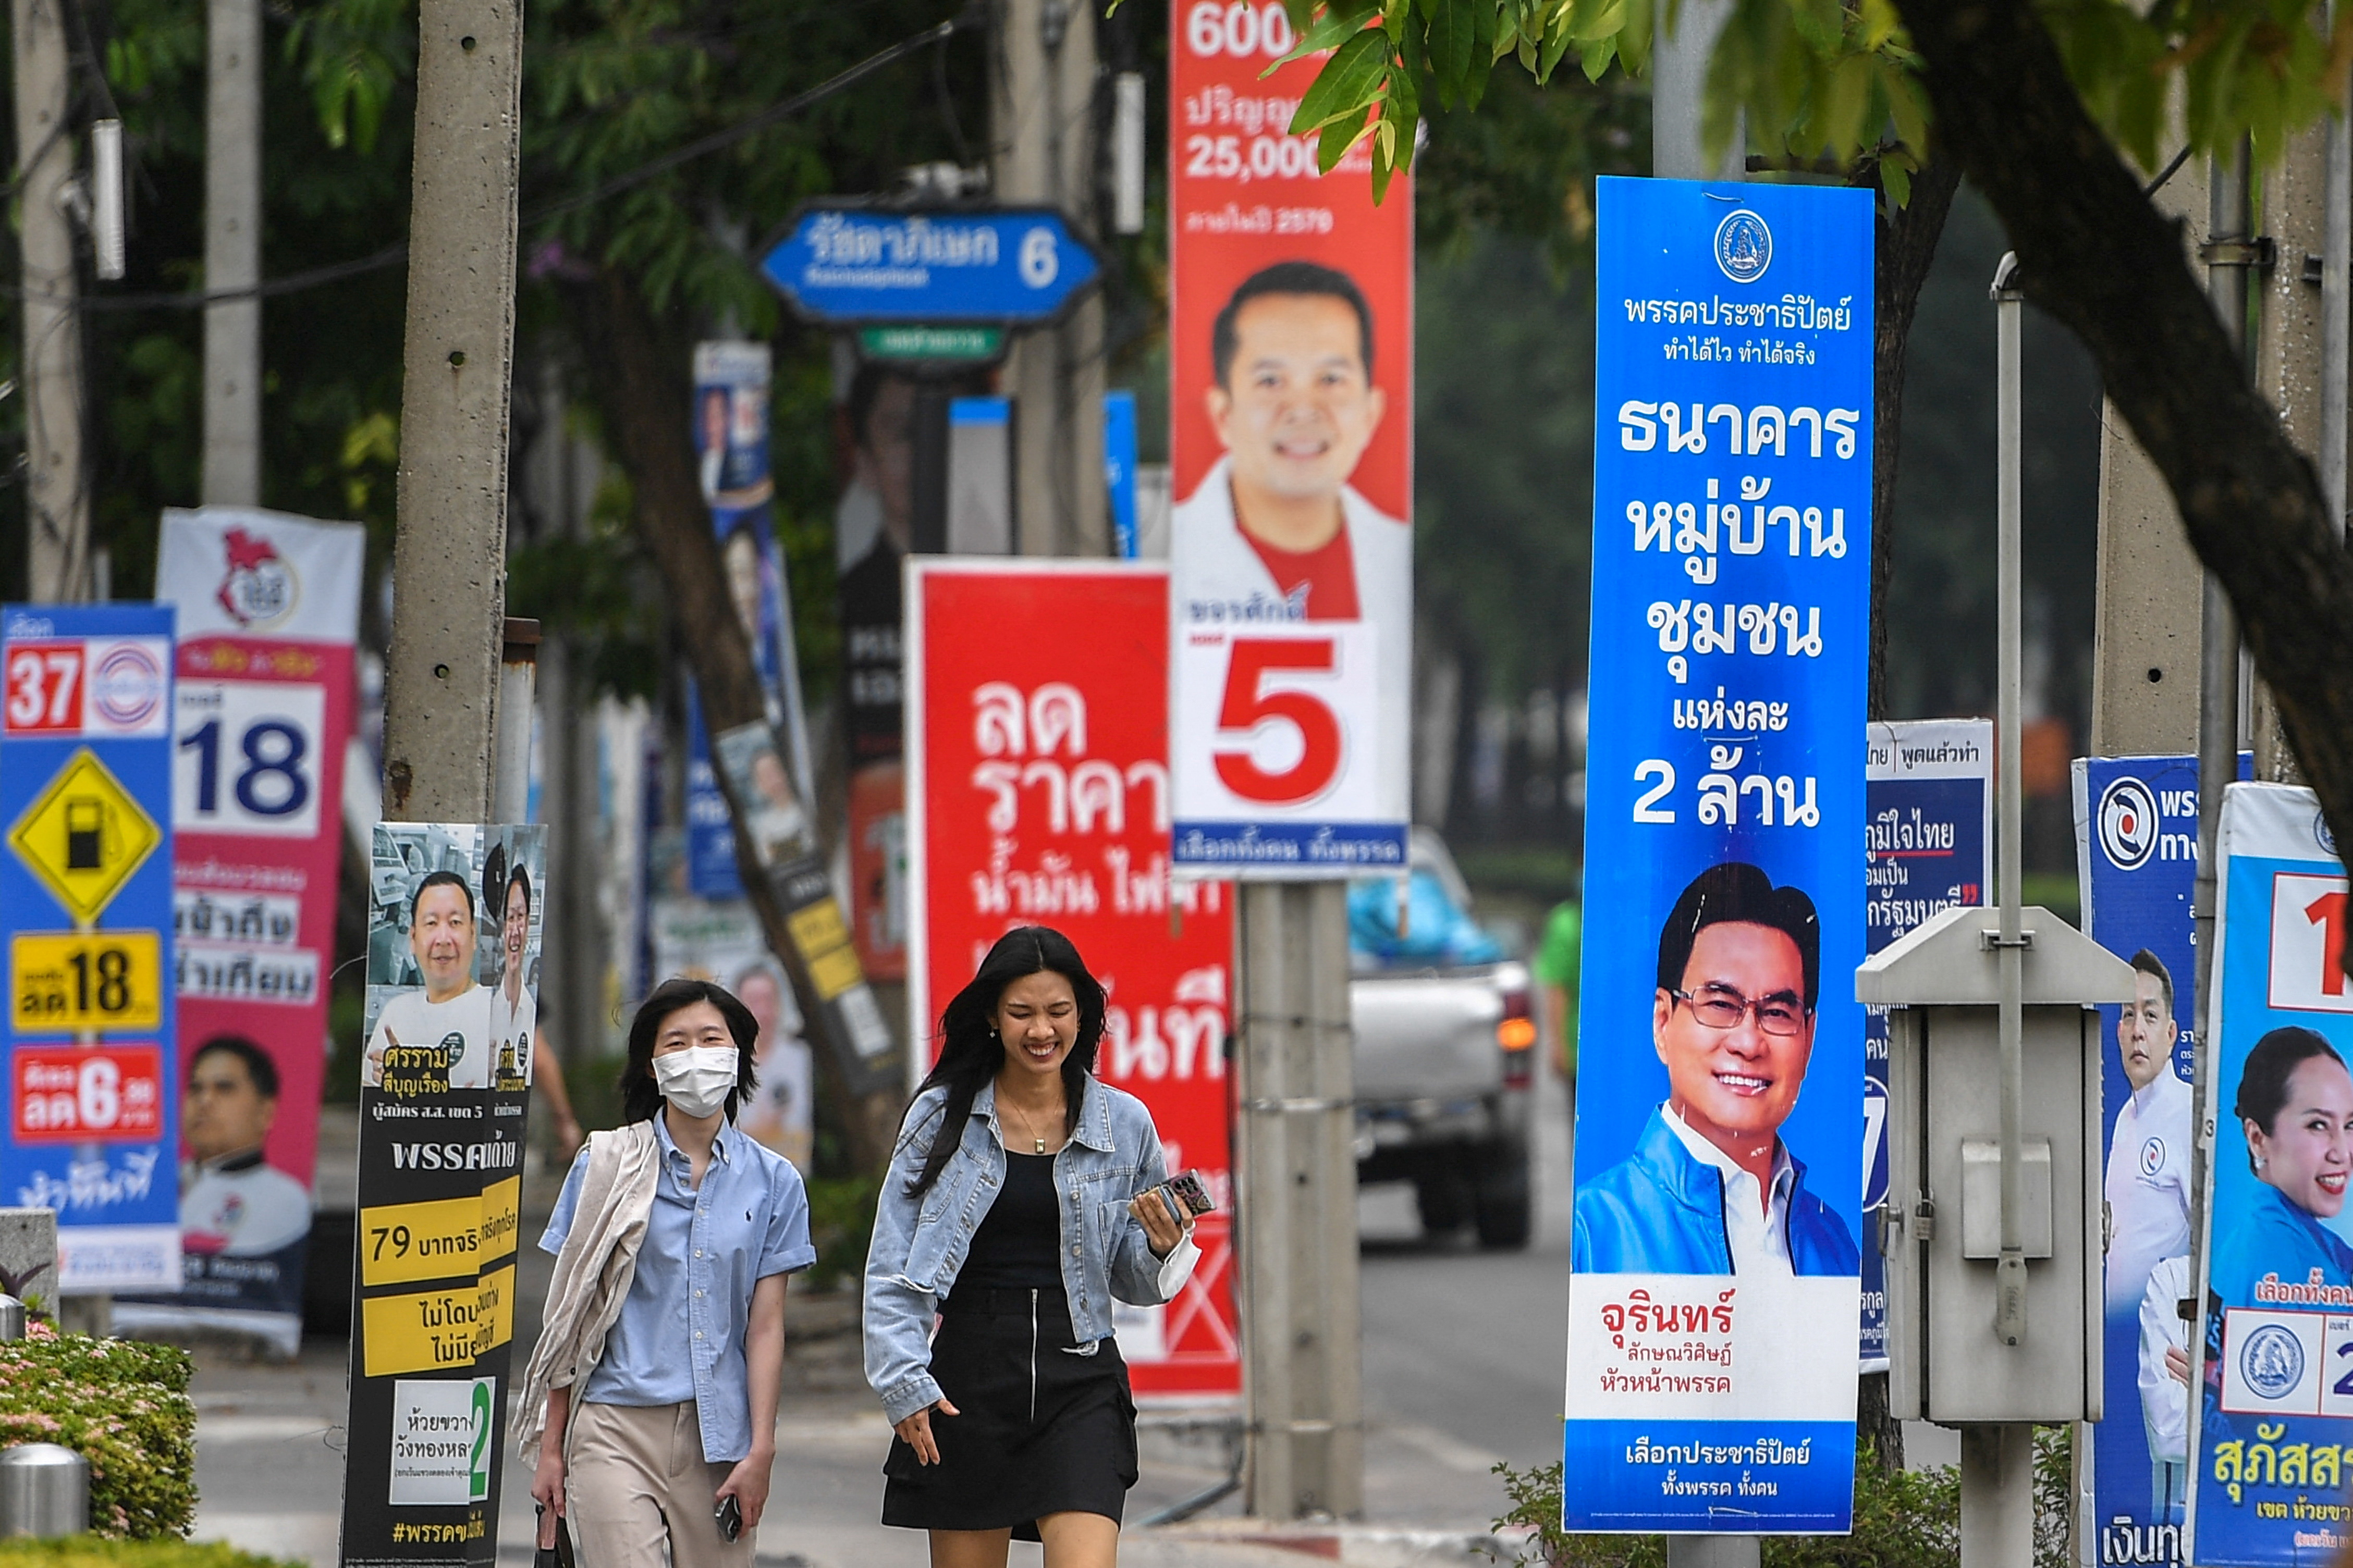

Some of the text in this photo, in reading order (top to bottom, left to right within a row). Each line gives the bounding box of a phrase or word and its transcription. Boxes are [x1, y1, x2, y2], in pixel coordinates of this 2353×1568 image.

[808, 211, 1059, 288] รัชดาภิเษก 6
[1624, 293, 1852, 331] พรรคประชาธิปัตย์
[1663, 336, 1815, 365] ทำได้ไว ทำได้จริง
[1617, 399, 1860, 460] ธนาคาร
[1626, 475, 1847, 585] หมู่บ้าน
[1646, 598, 1823, 684] ชุมชน
[10, 651, 79, 727] 37
[1673, 685, 1789, 732] แห่งละ
[972, 682, 1088, 757] ลด
[1212, 638, 1342, 805] 5
[180, 719, 308, 816] 18
[1902, 740, 1979, 770] พูดแล้วทำ
[972, 760, 1169, 834] ราคา
[1633, 744, 1820, 828] 2 ล้าน
[2160, 790, 2199, 817] พร
[972, 839, 1098, 914] น้ำมัน
[68, 948, 130, 1012] 18
[384, 1046, 448, 1068] ศรราม
[79, 1057, 120, 1130] 6
[372, 1101, 419, 1121] ผู้สมัคร
[421, 1106, 445, 1118] ส.ส.
[448, 1107, 471, 1118] เขต
[474, 1106, 483, 1119] 5
[391, 1142, 485, 1170] พรรค
[371, 1226, 481, 1261] 79 บาทจริ
[1600, 1288, 1736, 1349] จุรินทร์
[1627, 1341, 1732, 1367] ลักษณวิศิษฏ์
[1600, 1366, 1732, 1393] หัวหน้าพรรค
[396, 1434, 471, 1458] วังทองหล
[1625, 1436, 1811, 1465] เลือกประชาธิปัตย์
[1661, 1470, 1778, 1497] ทั้งพรรค ทั้งคน
[2256, 1502, 2288, 1518] เขต
[393, 1522, 468, 1543] #พรรคข
